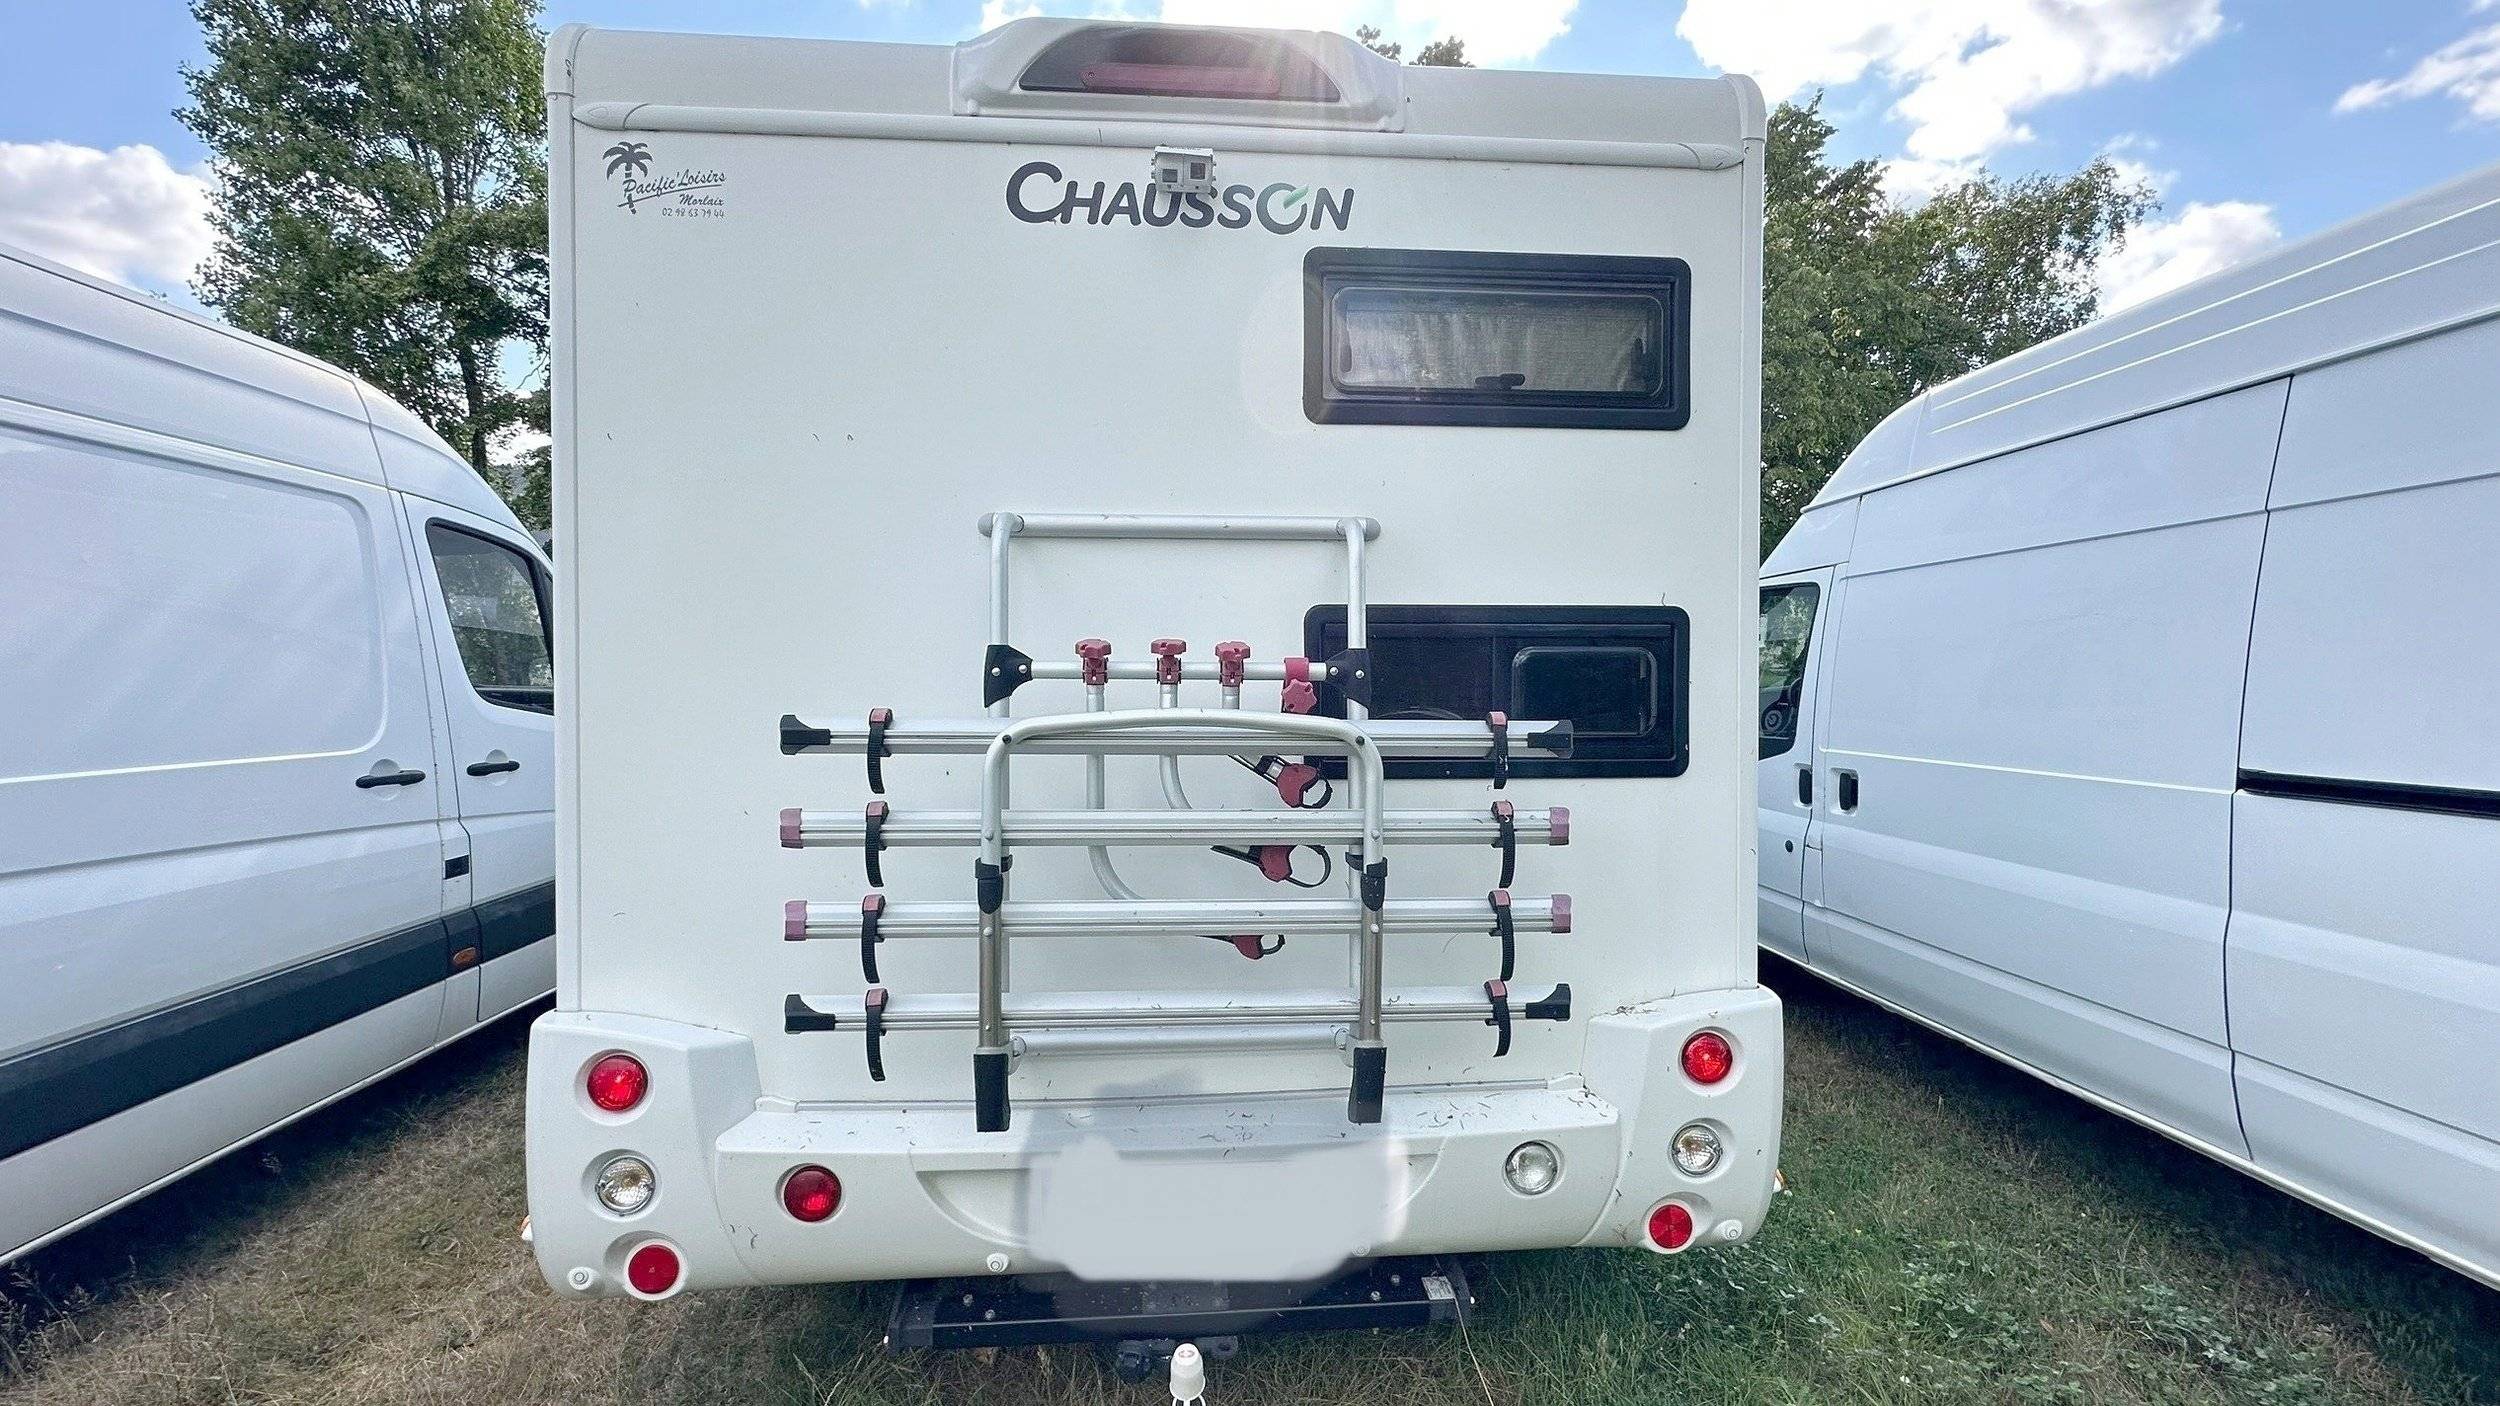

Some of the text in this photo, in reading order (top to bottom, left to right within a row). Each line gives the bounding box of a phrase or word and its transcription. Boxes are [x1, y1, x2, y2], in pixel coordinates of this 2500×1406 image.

[679, 193, 725, 206] Morlaix
[1005, 161, 1355, 235] CHAUSSON
[662, 207, 673, 217] 02
